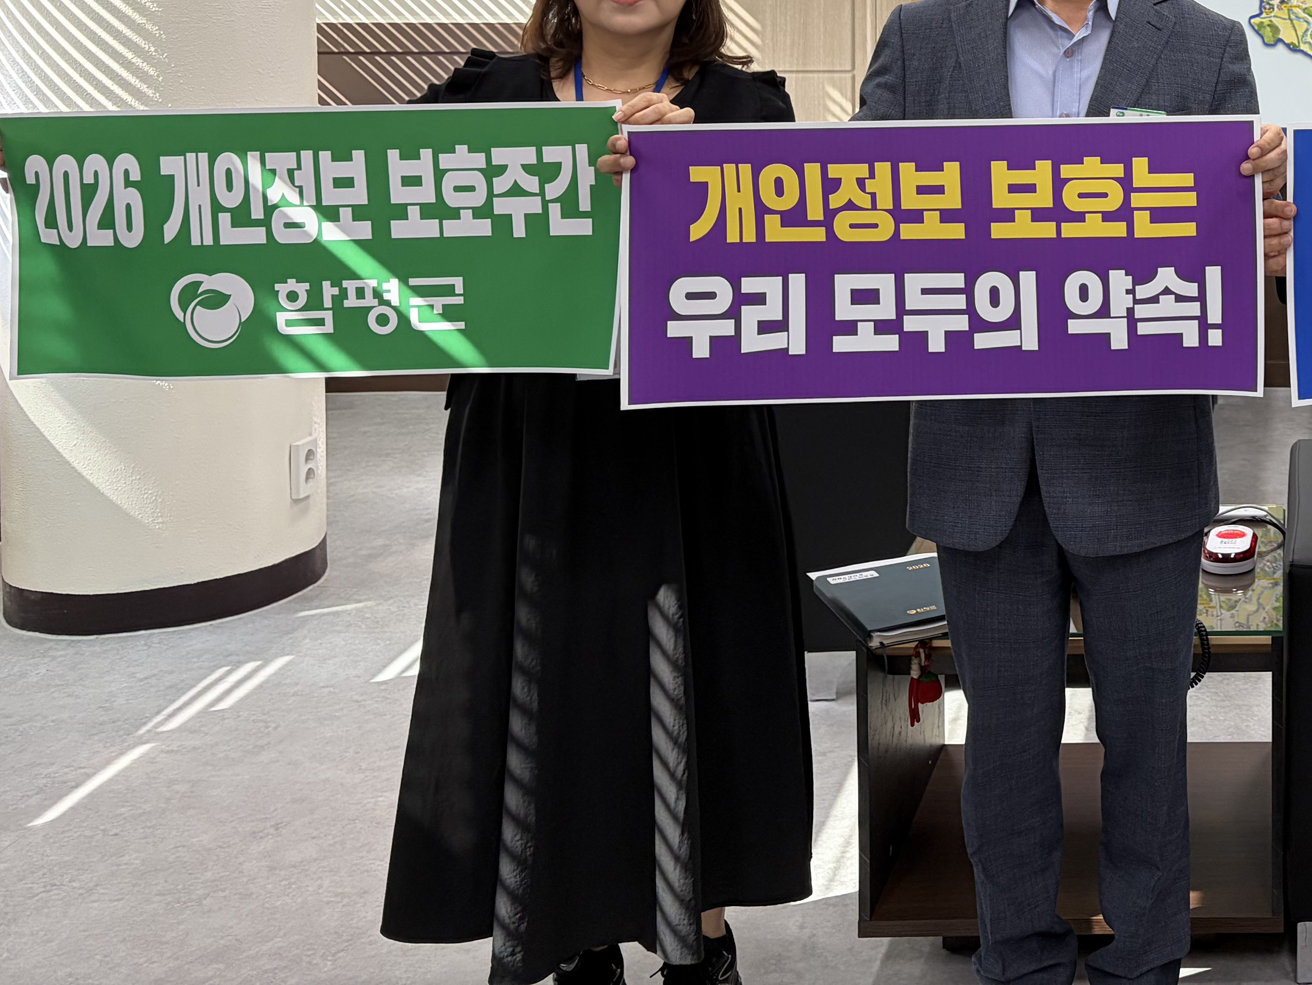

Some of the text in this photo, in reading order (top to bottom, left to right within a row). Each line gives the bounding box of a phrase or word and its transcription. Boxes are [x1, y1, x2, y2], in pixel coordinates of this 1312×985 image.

[25, 144, 595, 249] 2026 개인정보 보호주간
[689, 156, 1197, 243] 개인정보 보호는
[274, 276, 465, 335] 함평군
[667, 265, 1223, 358] 우리 모두의 약속!
